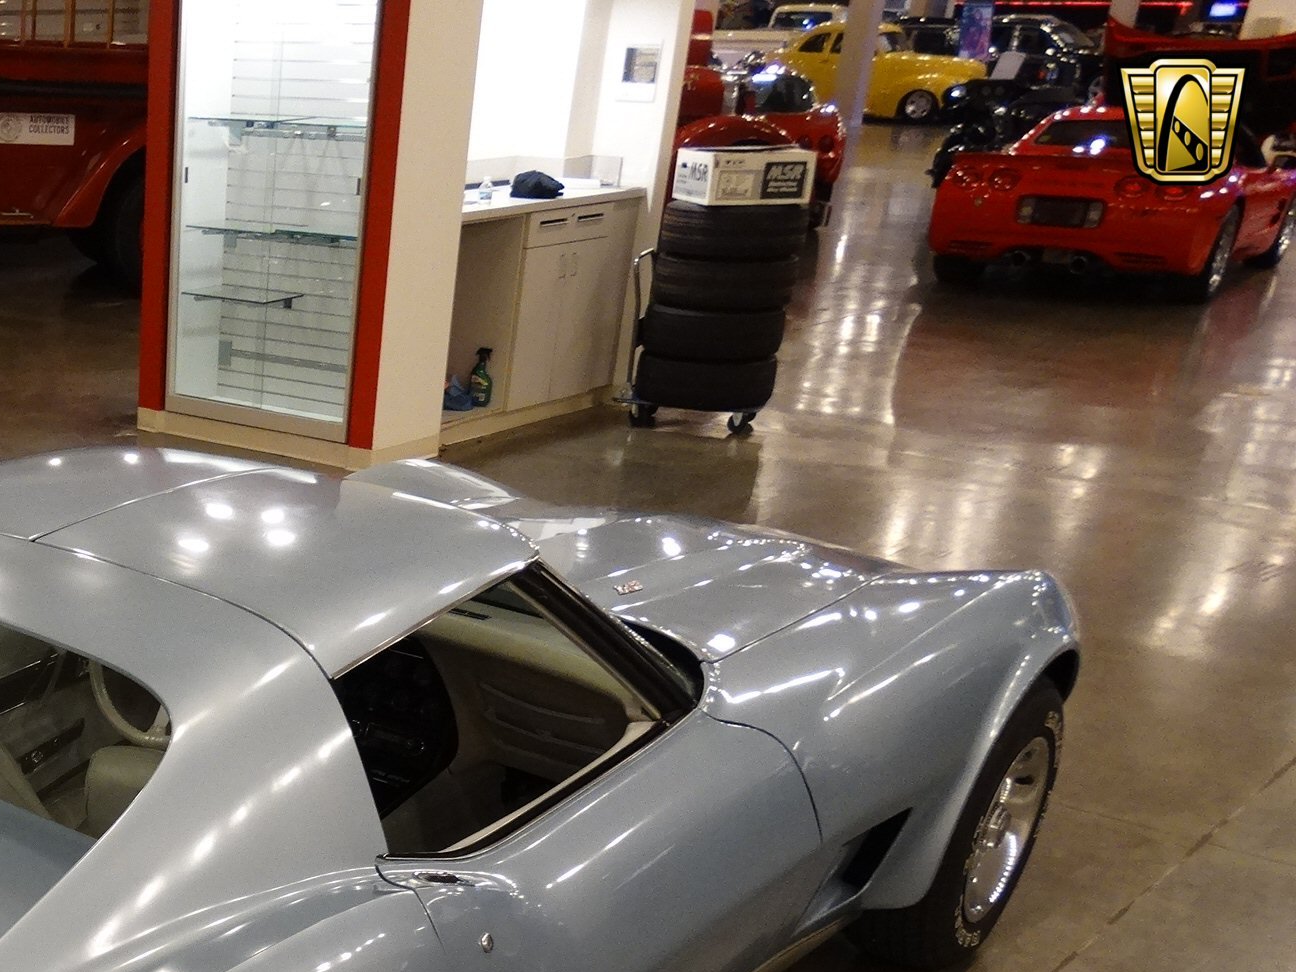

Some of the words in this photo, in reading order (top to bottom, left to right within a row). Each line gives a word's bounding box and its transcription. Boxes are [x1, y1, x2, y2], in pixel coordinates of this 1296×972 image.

[29, 124, 70, 134] COLLECTORS
[688, 161, 709, 182] MSR
[766, 164, 805, 180] MSR
